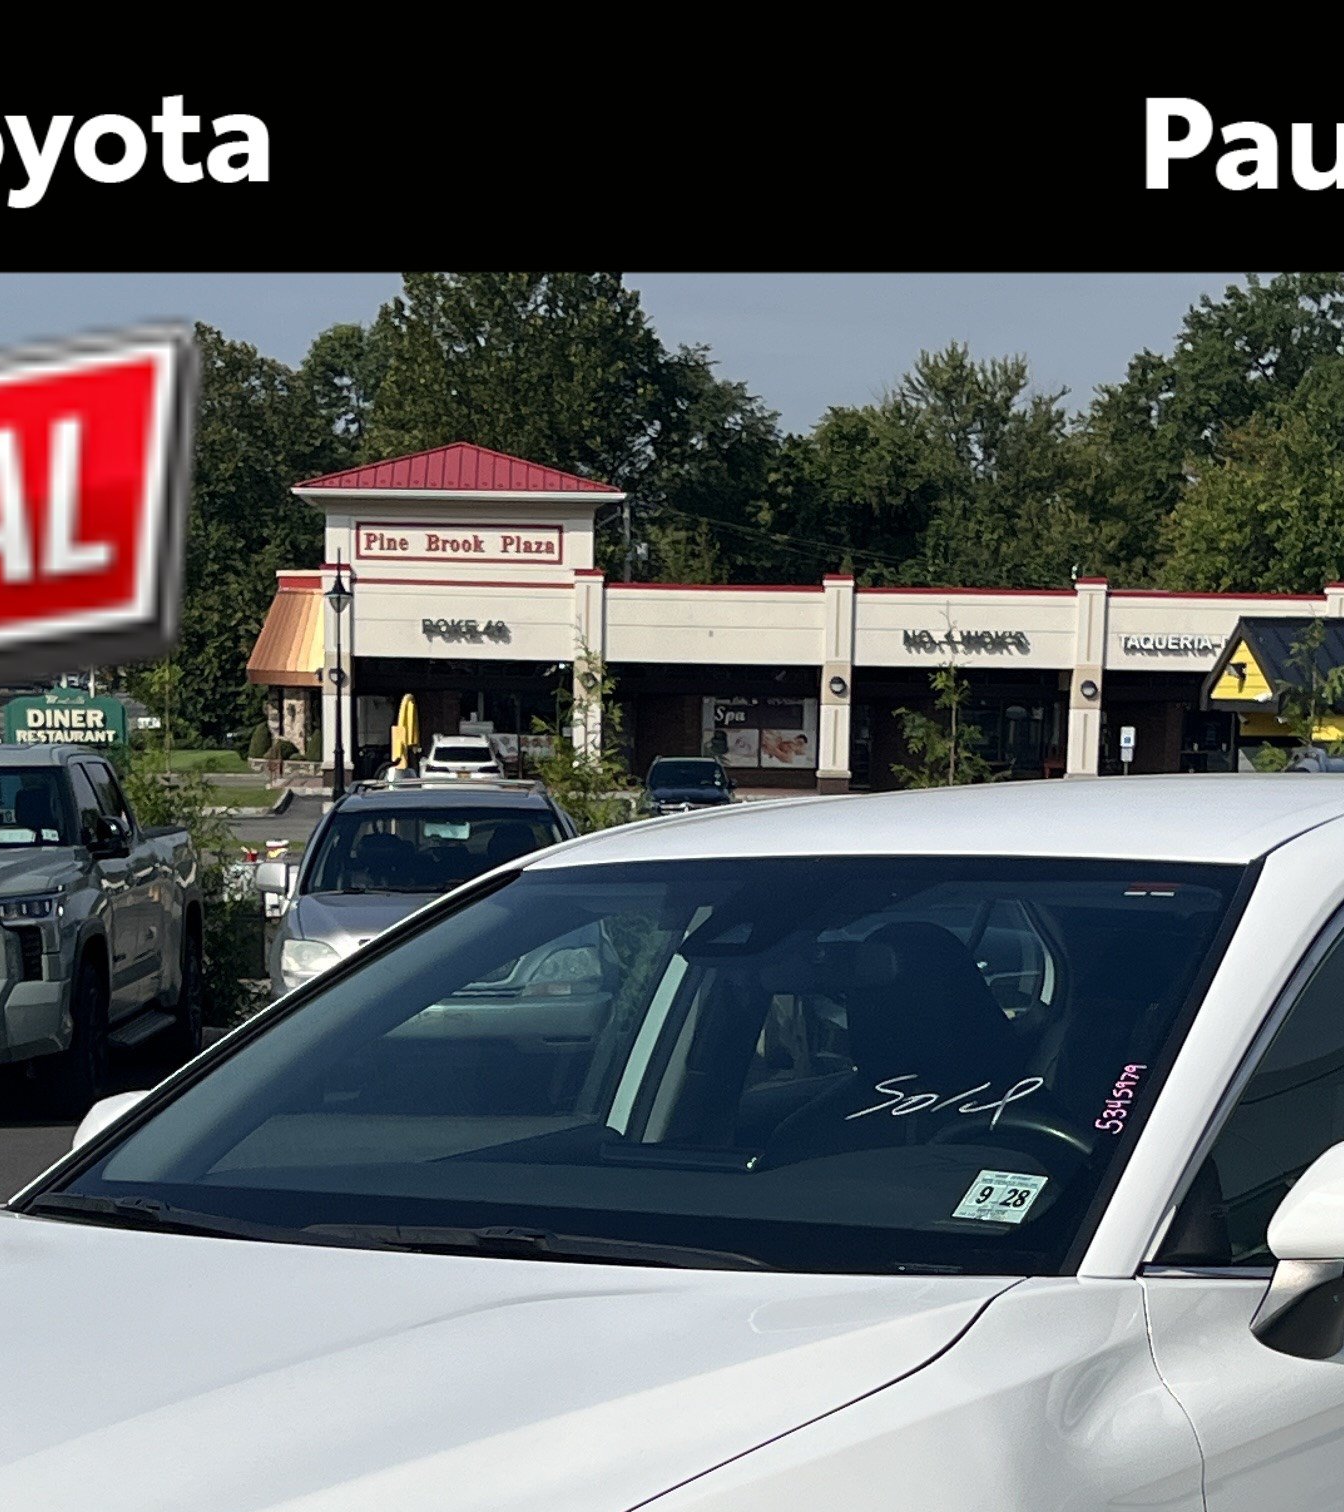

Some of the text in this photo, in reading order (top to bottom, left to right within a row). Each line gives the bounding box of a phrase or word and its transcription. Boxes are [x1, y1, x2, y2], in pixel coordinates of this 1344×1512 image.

[364, 532, 555, 554] Pine Brook Plaza
[1119, 634, 1213, 655] TAQUERIA
[26, 708, 104, 728] DINER
[715, 705, 746, 726] Spa
[16, 729, 116, 743] RESTAURANT
[975, 1185, 1031, 1208] 9 28
